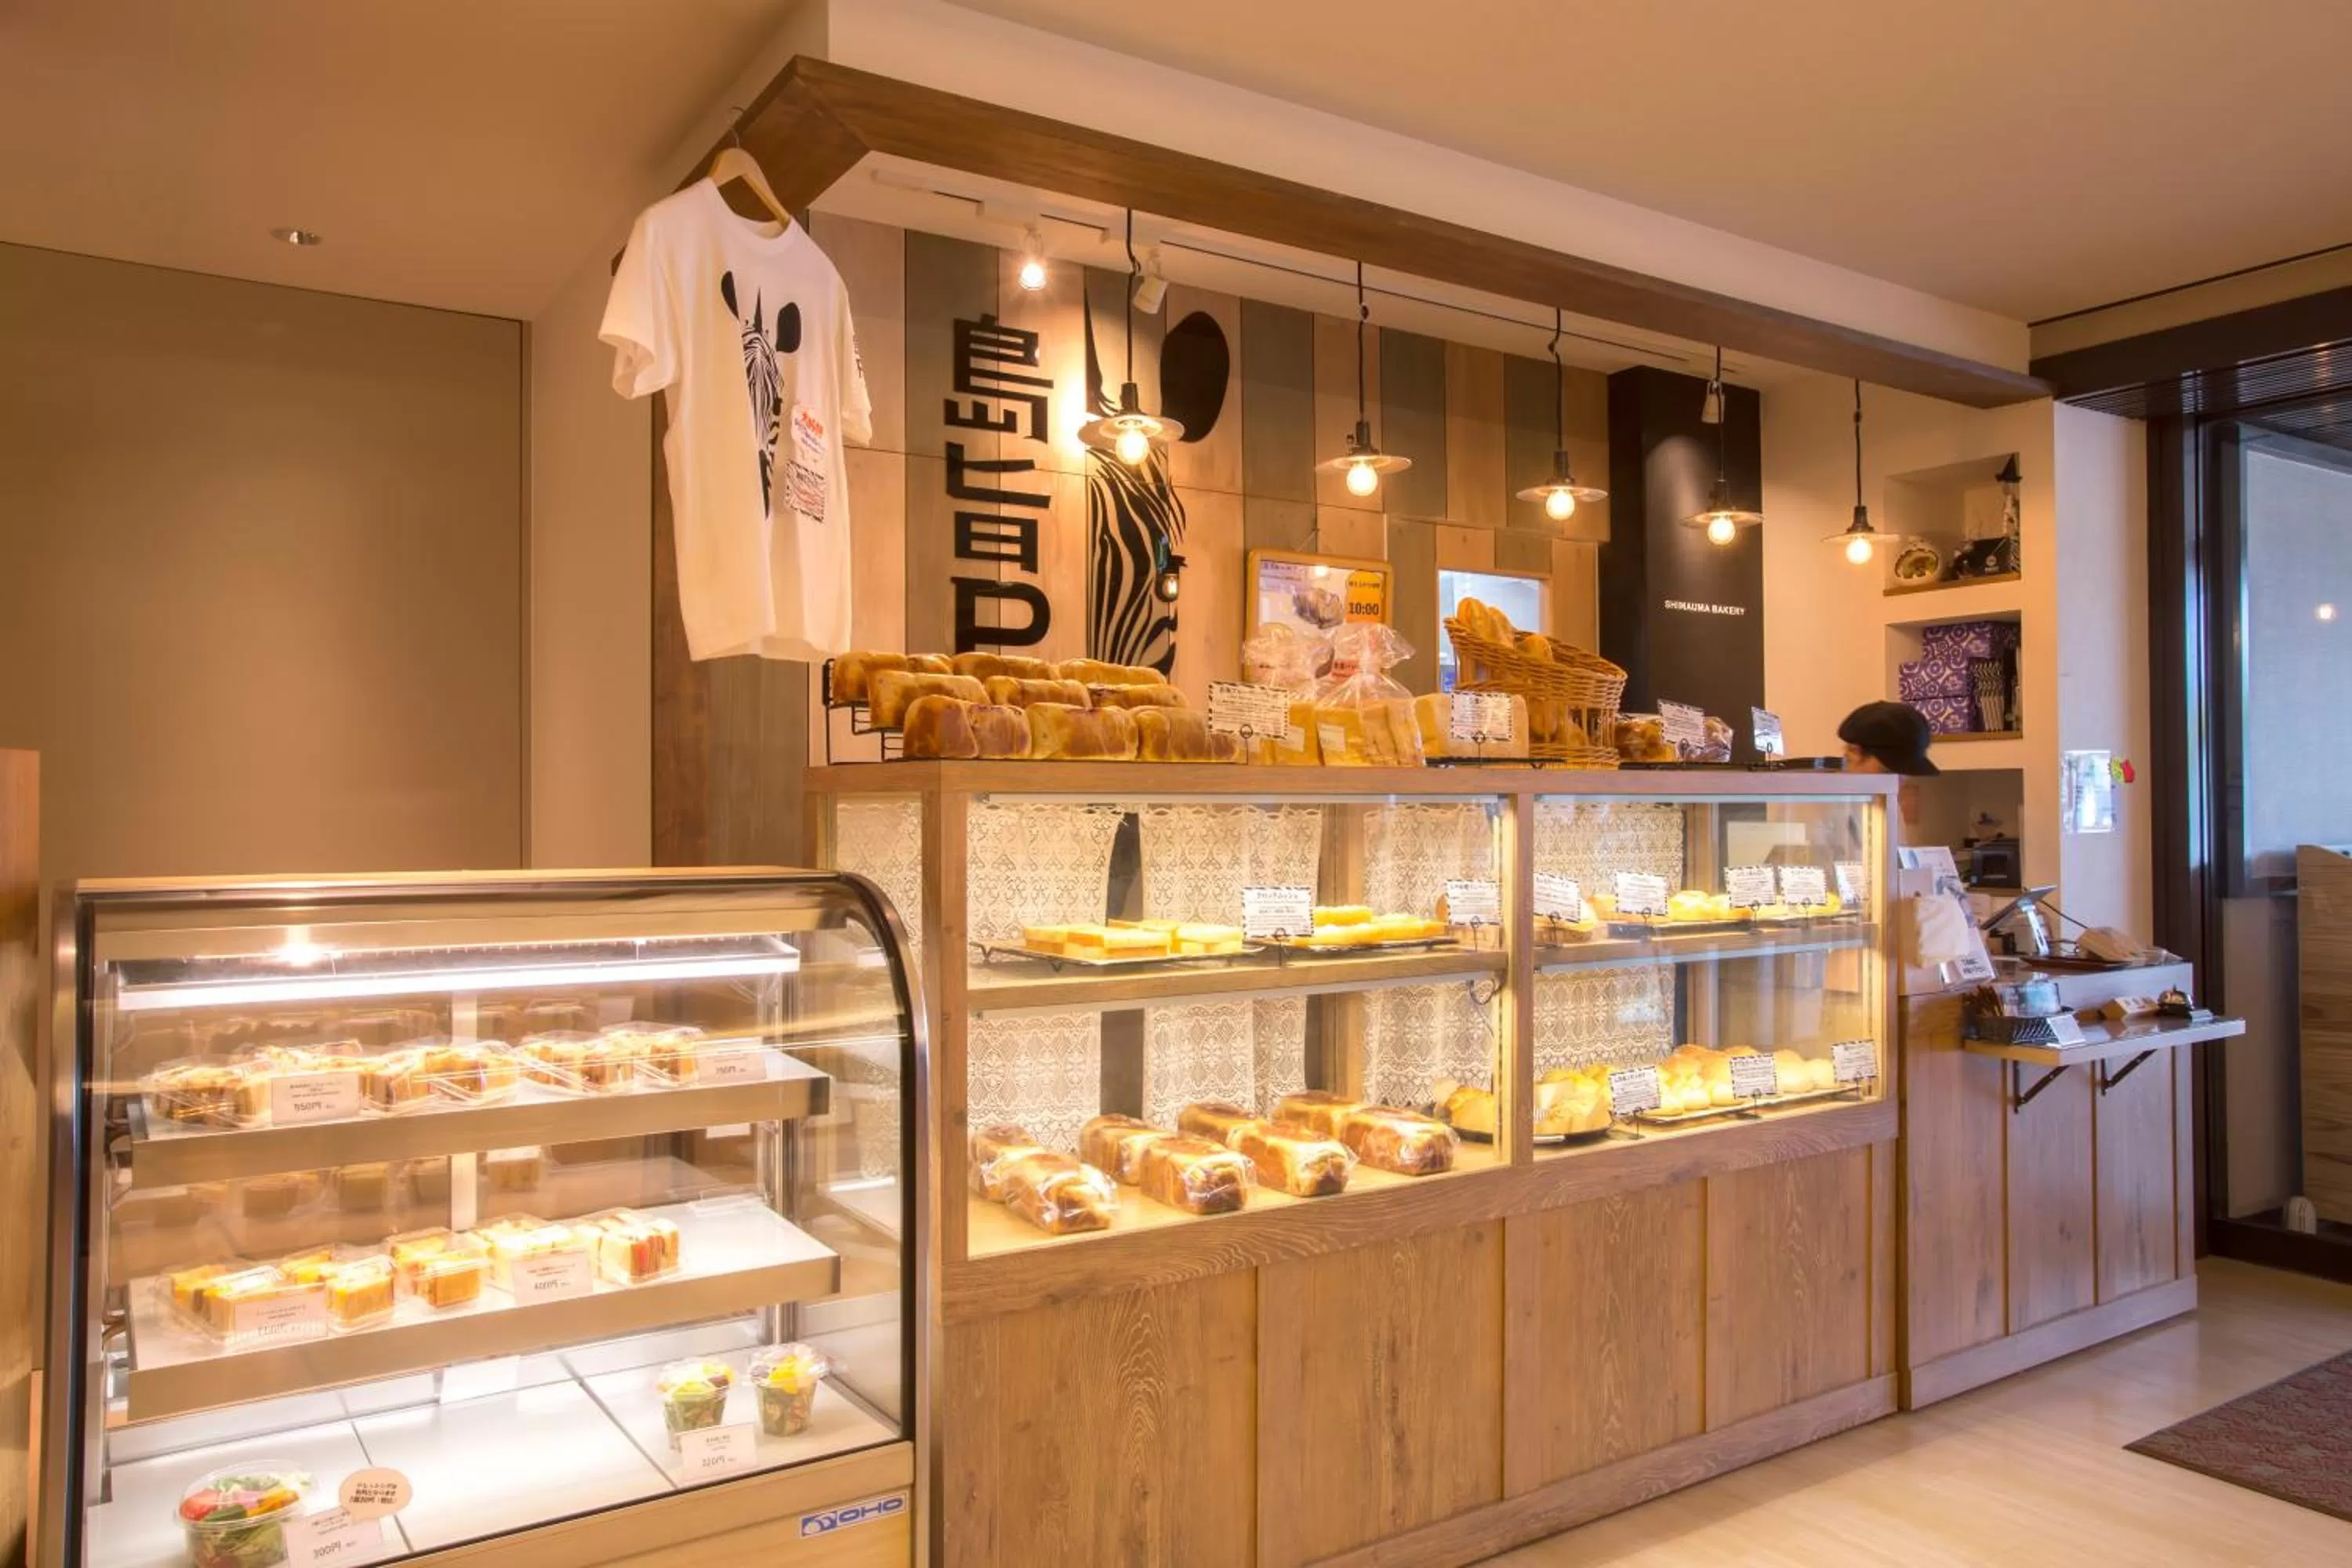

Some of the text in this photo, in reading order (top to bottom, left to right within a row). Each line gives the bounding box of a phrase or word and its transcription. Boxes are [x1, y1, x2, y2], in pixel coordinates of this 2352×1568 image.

[1348, 601, 1380, 616] 10:00
[1664, 600, 1745, 615] SHIMAUMA BAKERY
[838, 1497, 904, 1523] OHO
